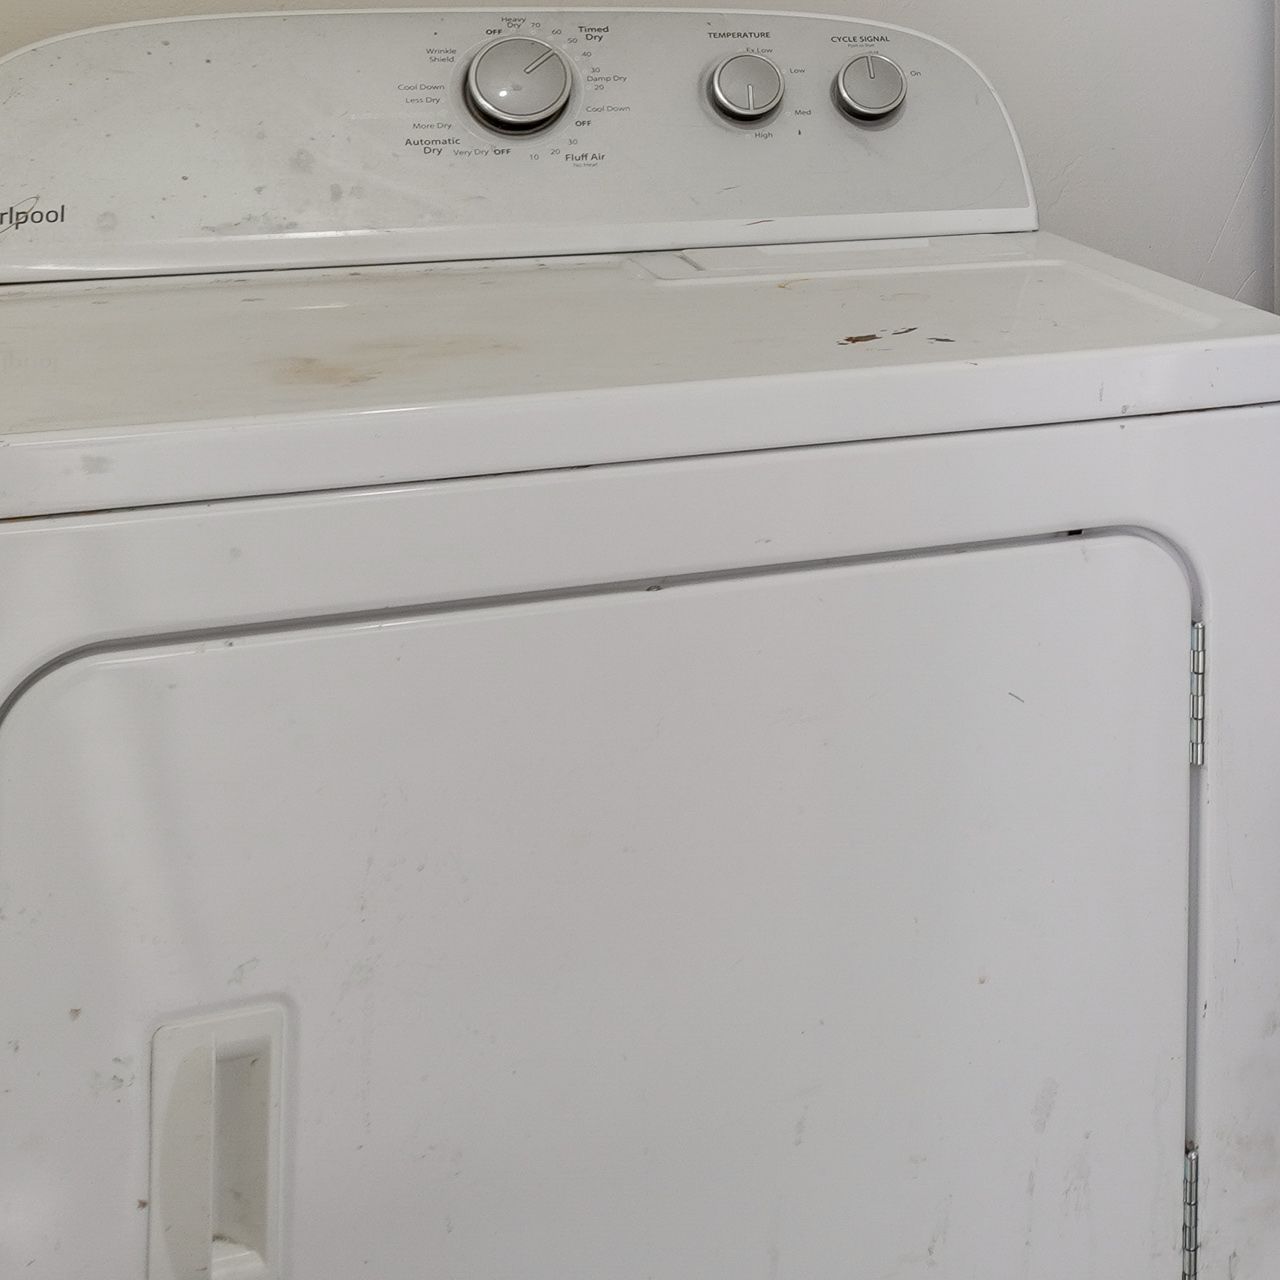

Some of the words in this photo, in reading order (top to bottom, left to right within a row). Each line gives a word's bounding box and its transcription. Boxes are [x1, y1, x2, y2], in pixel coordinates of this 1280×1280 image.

[585, 33, 603, 42] Dry
[426, 97, 441, 105] Dry
[437, 122, 452, 130] Dry
[405, 138, 461, 146] Automatic
[423, 147, 443, 155] Dry
[565, 153, 588, 161] Fluff
[0, 204, 65, 230] rlpool
